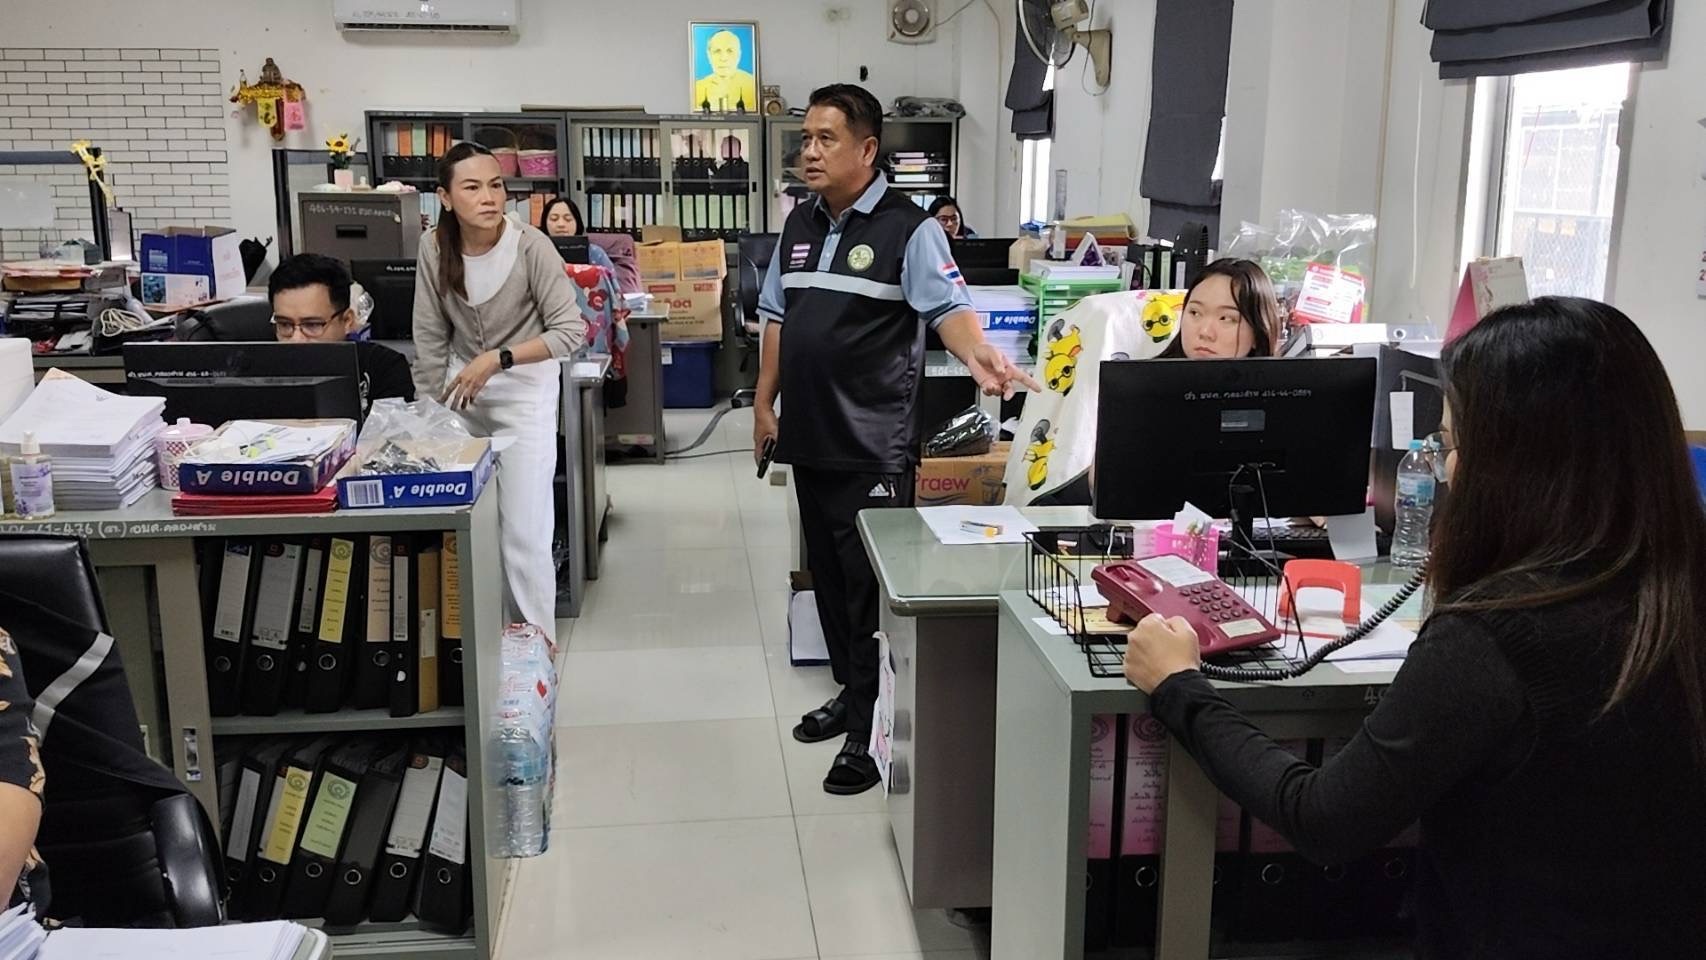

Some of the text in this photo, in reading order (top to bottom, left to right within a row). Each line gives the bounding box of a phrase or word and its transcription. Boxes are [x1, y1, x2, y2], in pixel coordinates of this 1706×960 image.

[1004, 316, 1036, 324] Double
[196, 470, 299, 486] Double A
[393, 482, 467, 498] Double A
